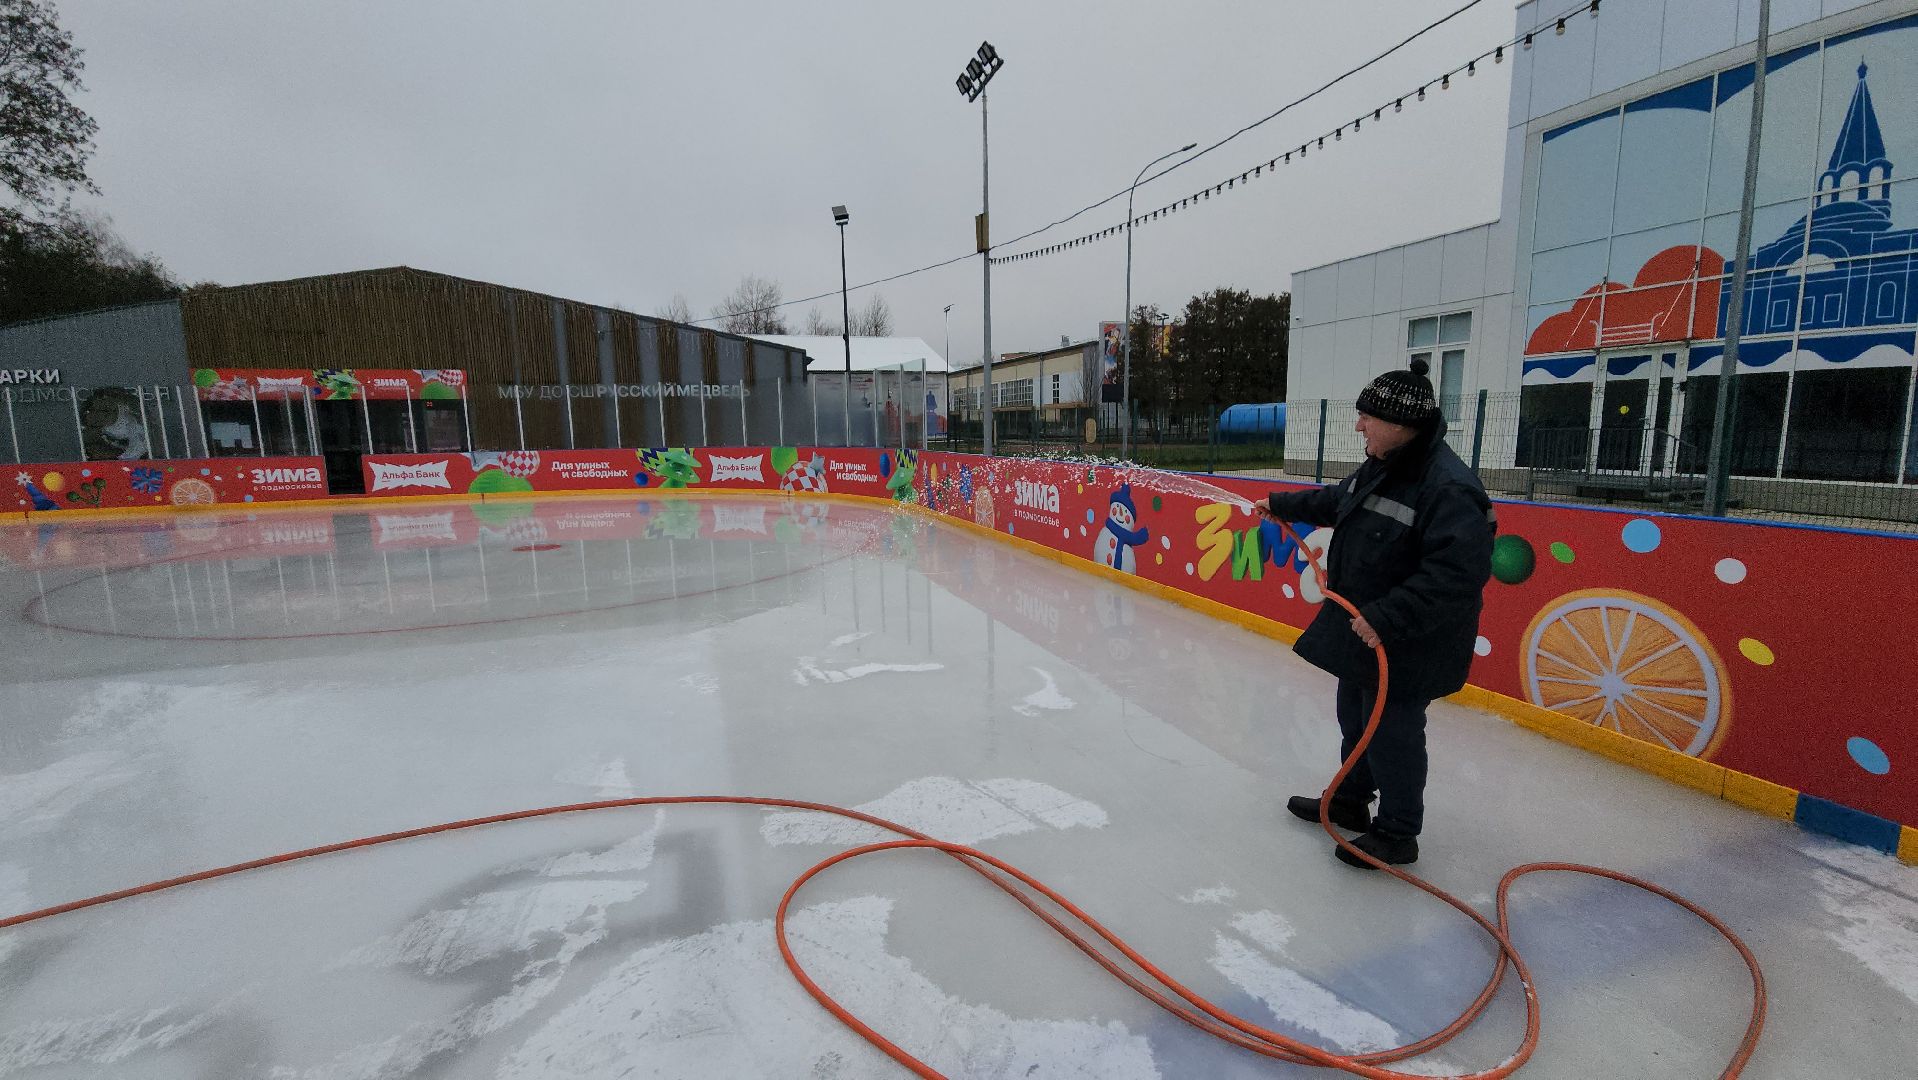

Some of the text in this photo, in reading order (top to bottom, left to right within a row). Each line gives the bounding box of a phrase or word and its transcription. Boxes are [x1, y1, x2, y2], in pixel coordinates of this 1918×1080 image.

[551, 461, 610, 472] Для умных
[716, 463, 758, 474] Альфа Банк
[829, 459, 867, 473] Для умных
[381, 470, 441, 482] Альфа Банк
[561, 469, 629, 479] и свободных
[836, 470, 878, 483] и свободных
